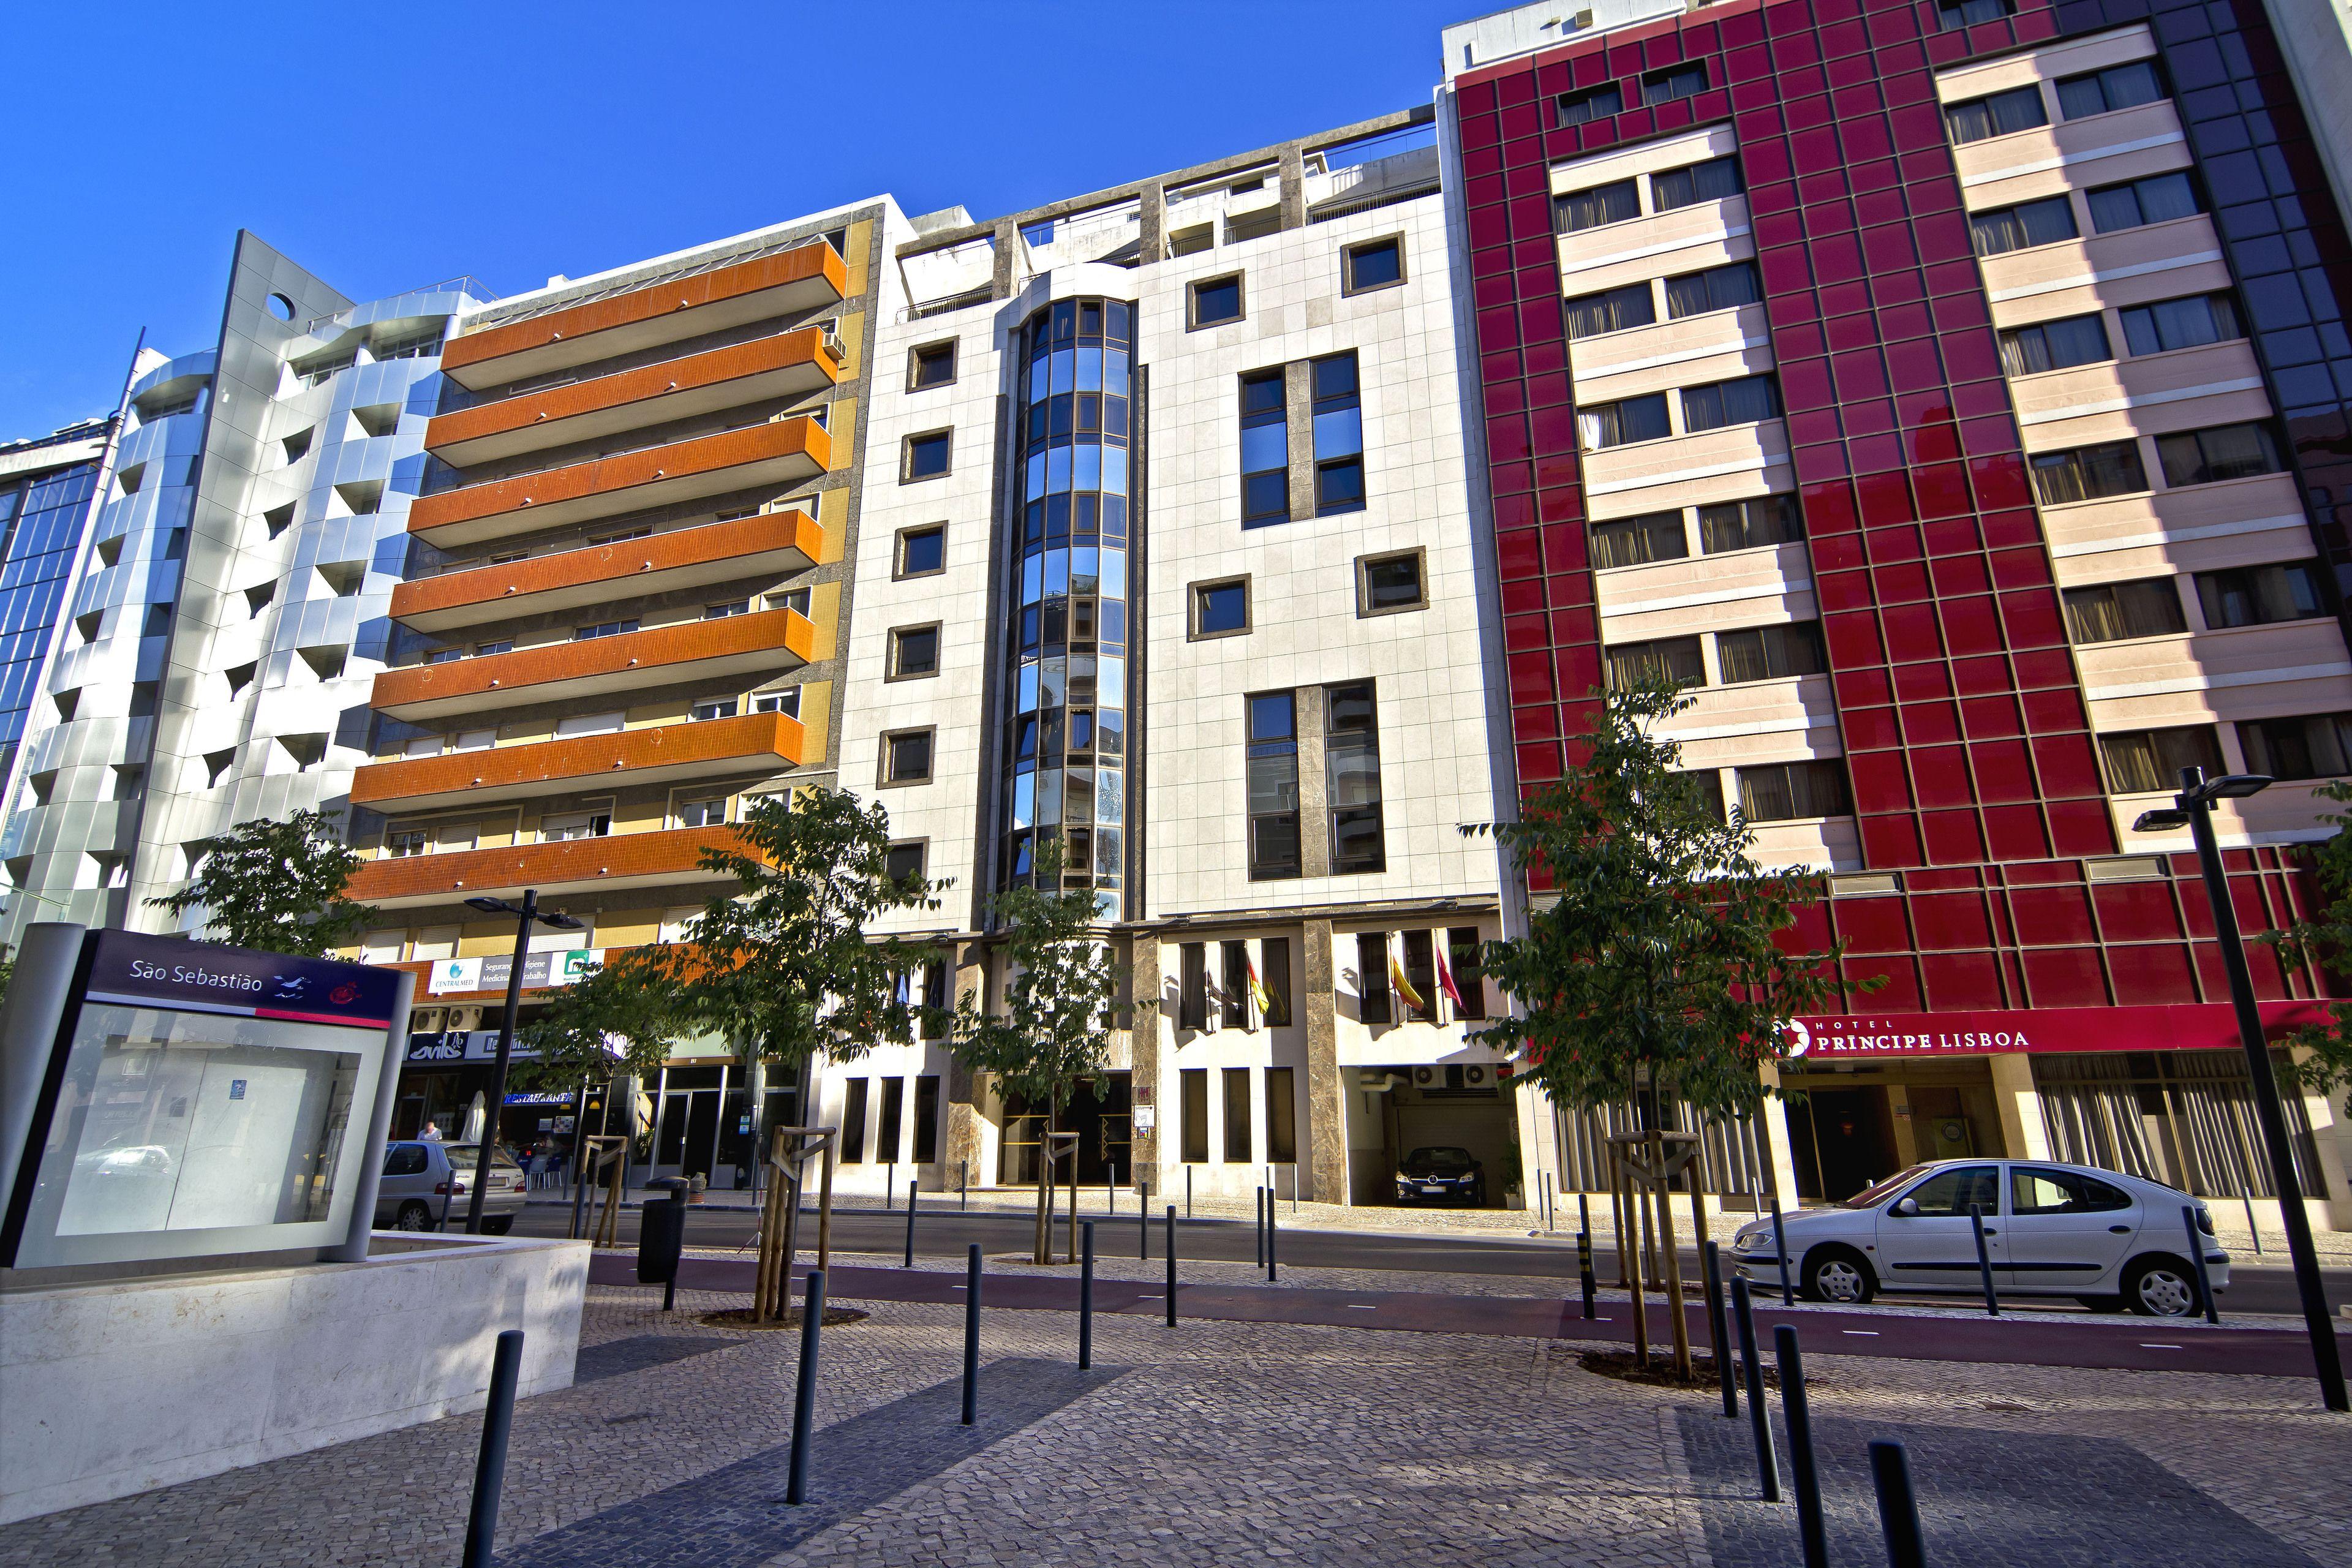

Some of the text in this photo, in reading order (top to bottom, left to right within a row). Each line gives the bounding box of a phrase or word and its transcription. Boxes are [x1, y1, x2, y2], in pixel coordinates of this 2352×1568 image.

[485, 963, 513, 972] Seguranç
[129, 960, 262, 991] São Sebastião
[1815, 1020, 1892, 1030] HOTEL
[1939, 1031, 2029, 1048] LISBOA
